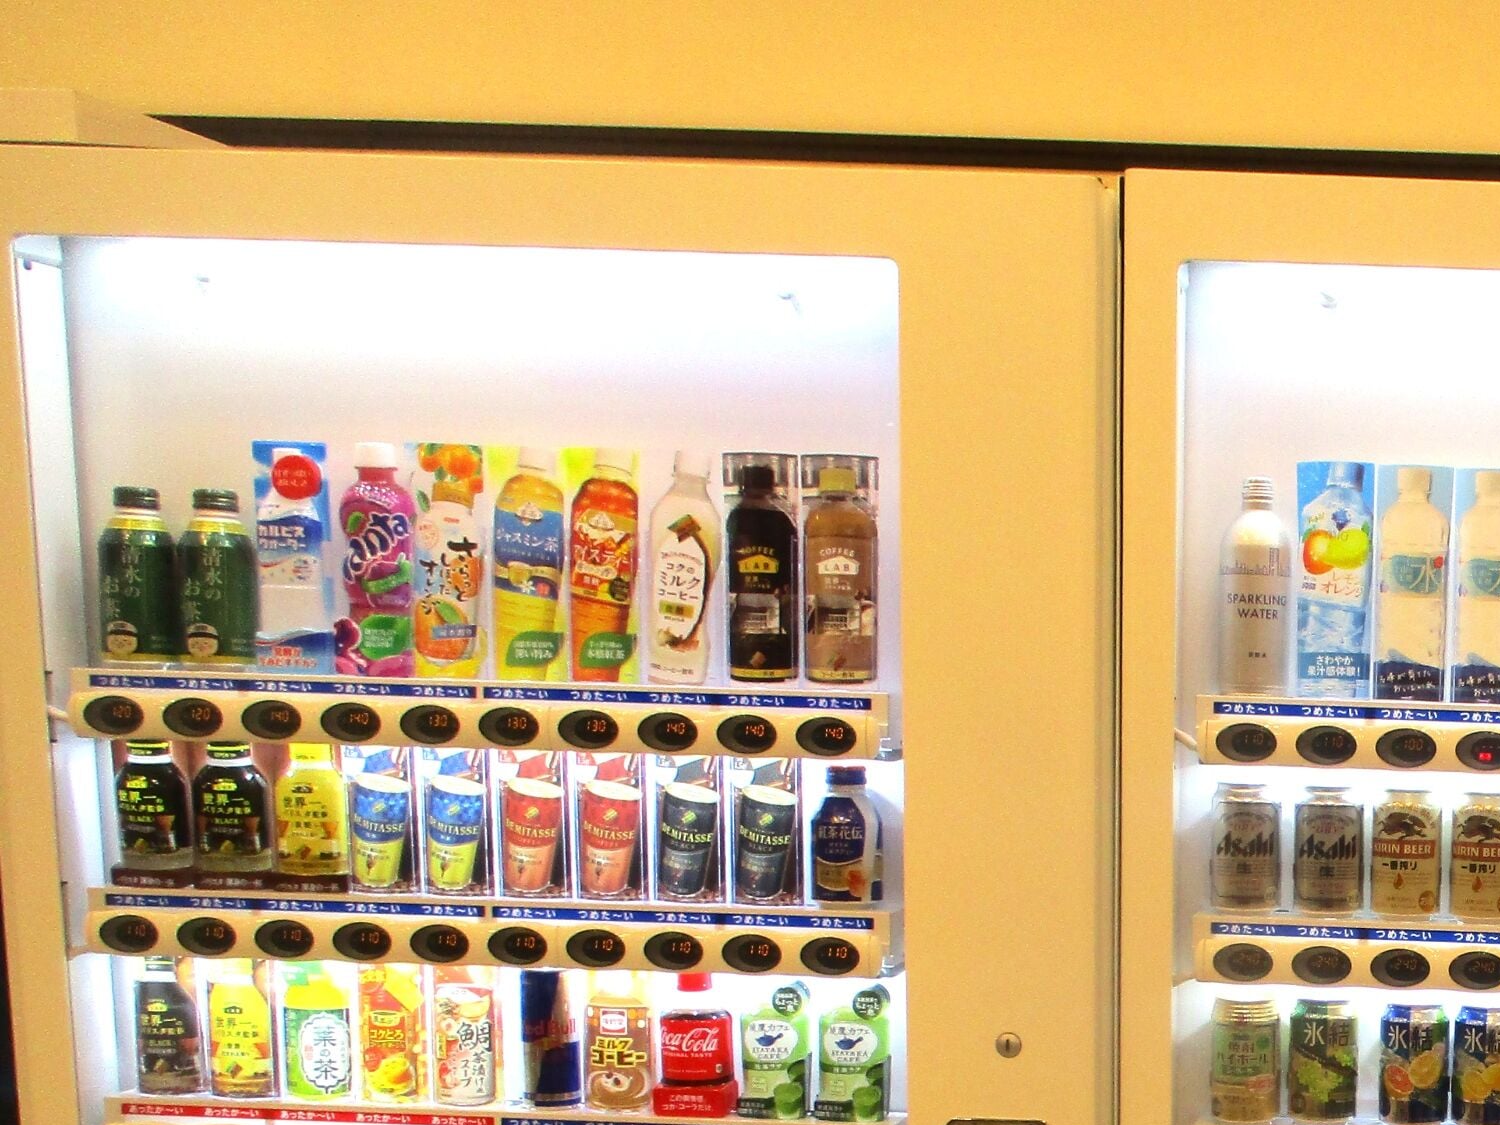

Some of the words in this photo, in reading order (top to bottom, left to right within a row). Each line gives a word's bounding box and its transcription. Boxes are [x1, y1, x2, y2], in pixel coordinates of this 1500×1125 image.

[257, 524, 305, 538] カルピス
[496, 527, 560, 553] ジャスミン茶
[819, 547, 855, 557] COFFEE
[666, 562, 695, 575] コクの
[744, 563, 770, 571] LAB
[824, 563, 850, 571] LAB
[659, 571, 701, 590] ミルク
[658, 588, 700, 601] コーヒー
[1227, 593, 1287, 606] SPARKLING
[1237, 607, 1279, 620] WATER
[1316, 655, 1354, 666] さわやか
[508, 717, 526, 730] 130
[587, 720, 606, 733] 130
[666, 722, 685, 735] 140
[825, 727, 843, 740] 140
[818, 824, 863, 841] 紅茶花伝
[1216, 830, 1274, 857] Asahi
[1300, 833, 1356, 860] Asahi
[1374, 842, 1401, 854] KIRIN
[1404, 843, 1432, 855] BEER
[1381, 861, 1418, 872] 一番搾り
[1460, 863, 1497, 874] 一番搾り
[594, 938, 613, 951] 110
[828, 946, 847, 959] 110
[369, 1029, 404, 1040] コクとろ
[1303, 1021, 1350, 1047] 氷結
[595, 1036, 633, 1050] ミルク
[591, 1048, 648, 1067] コーヒー
[460, 1058, 472, 1087] スープ
